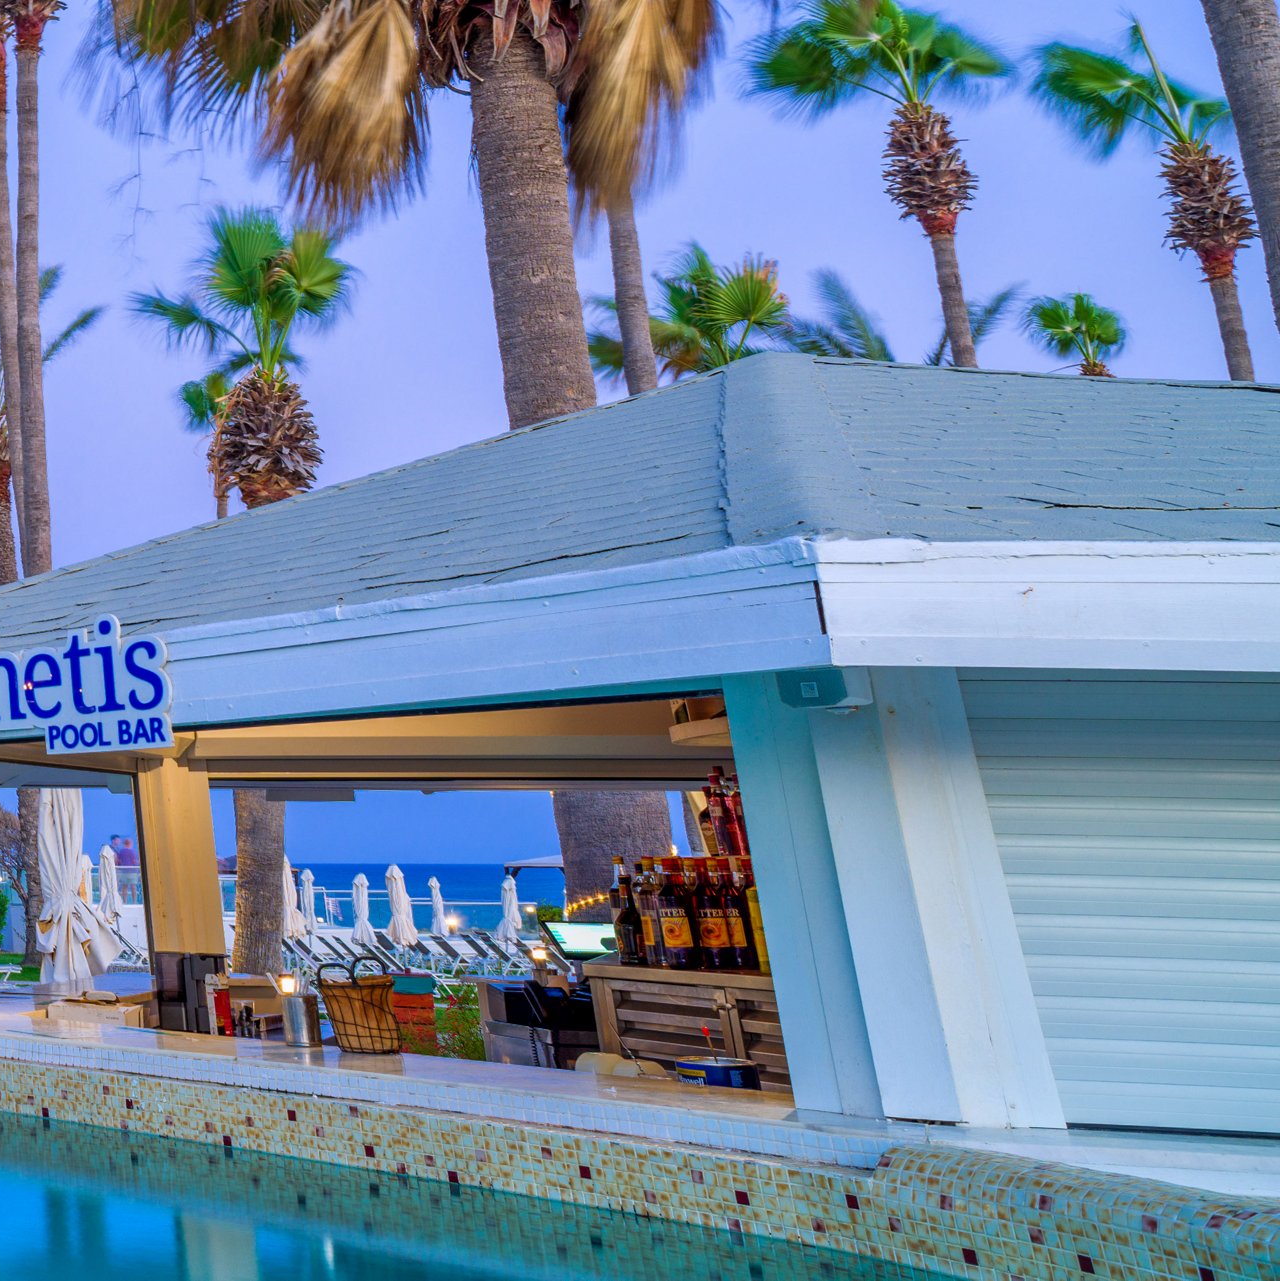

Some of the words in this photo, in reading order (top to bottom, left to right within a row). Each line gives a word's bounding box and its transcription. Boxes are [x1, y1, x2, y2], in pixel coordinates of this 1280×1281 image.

[48, 722, 111, 749] POOL
[118, 717, 166, 745] BAR
[659, 908, 686, 917] ITTER
[698, 908, 724, 917] TTER
